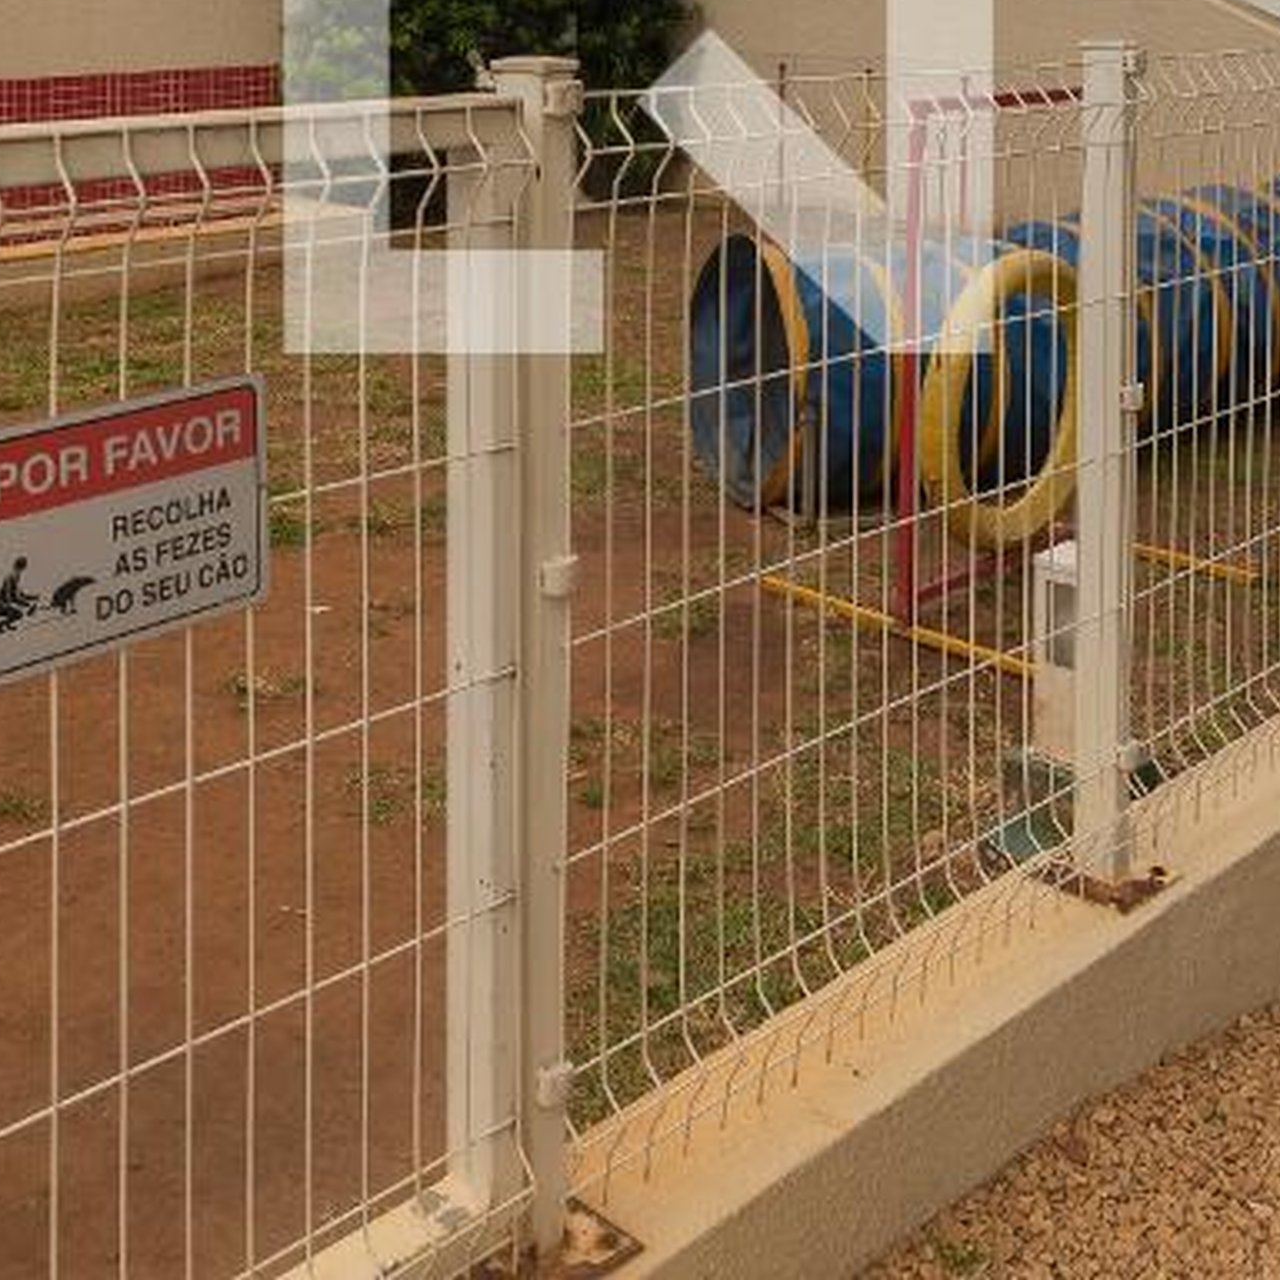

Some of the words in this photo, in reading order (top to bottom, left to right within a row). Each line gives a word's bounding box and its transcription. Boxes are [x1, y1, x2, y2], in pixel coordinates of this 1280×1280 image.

[104, 409, 242, 477] FAVOR
[111, 487, 232, 542] RECOLHA
[114, 552, 148, 578] AS
[155, 522, 232, 568] FEZES
[95, 590, 134, 621] DO
[142, 577, 191, 608] SEU
[198, 553, 249, 592] CÃO
